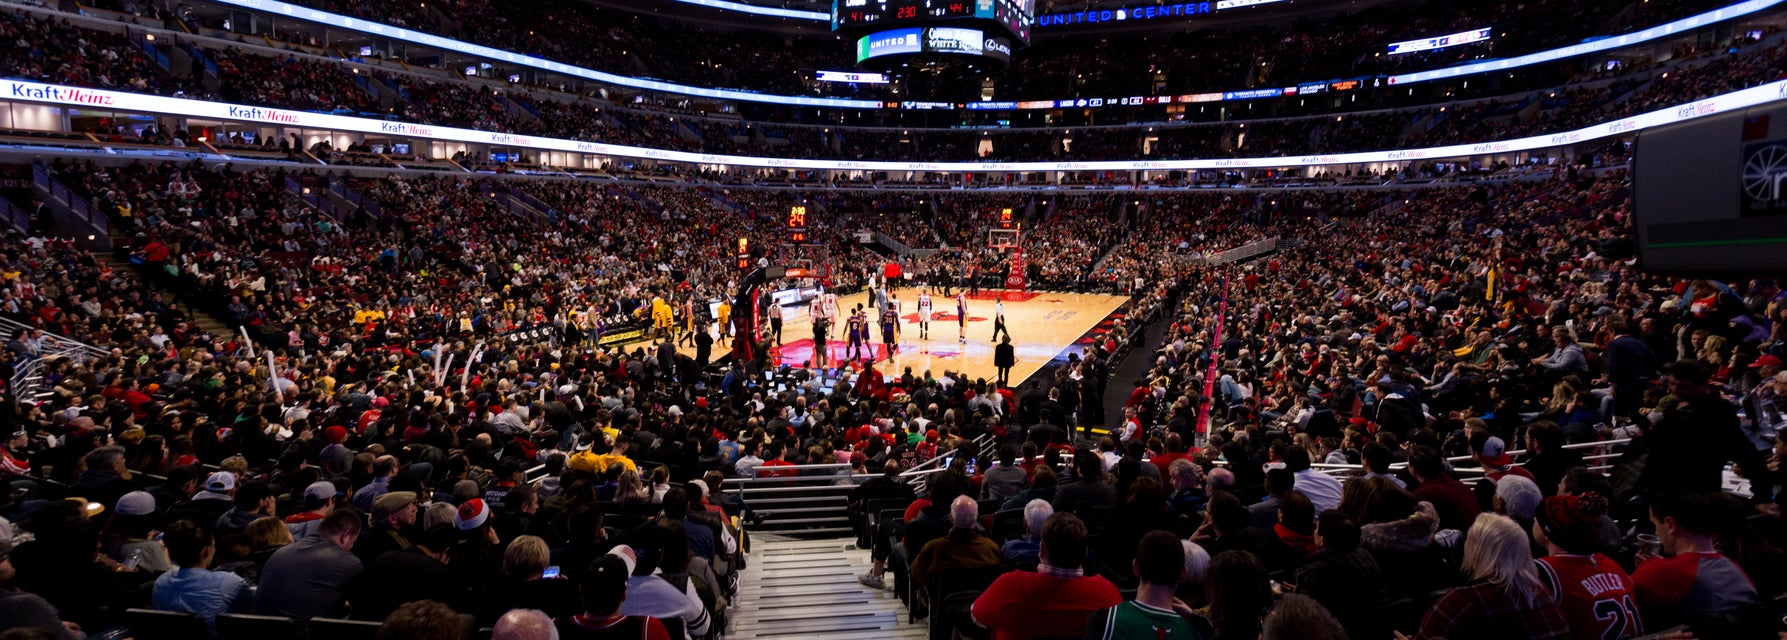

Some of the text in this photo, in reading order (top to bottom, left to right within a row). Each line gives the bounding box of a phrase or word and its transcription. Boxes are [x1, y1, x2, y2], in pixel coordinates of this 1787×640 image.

[898, 6, 916, 18] 2:30
[1040, 10, 1112, 26] UNITED
[1132, 2, 1210, 18] CENTER
[870, 37, 904, 48] UNITED
[929, 40, 957, 48] WHITE
[791, 206, 806, 215] 2:30
[789, 214, 804, 227] 24
[1581, 573, 1626, 596] BUTLER
[1593, 594, 1644, 640] 21
